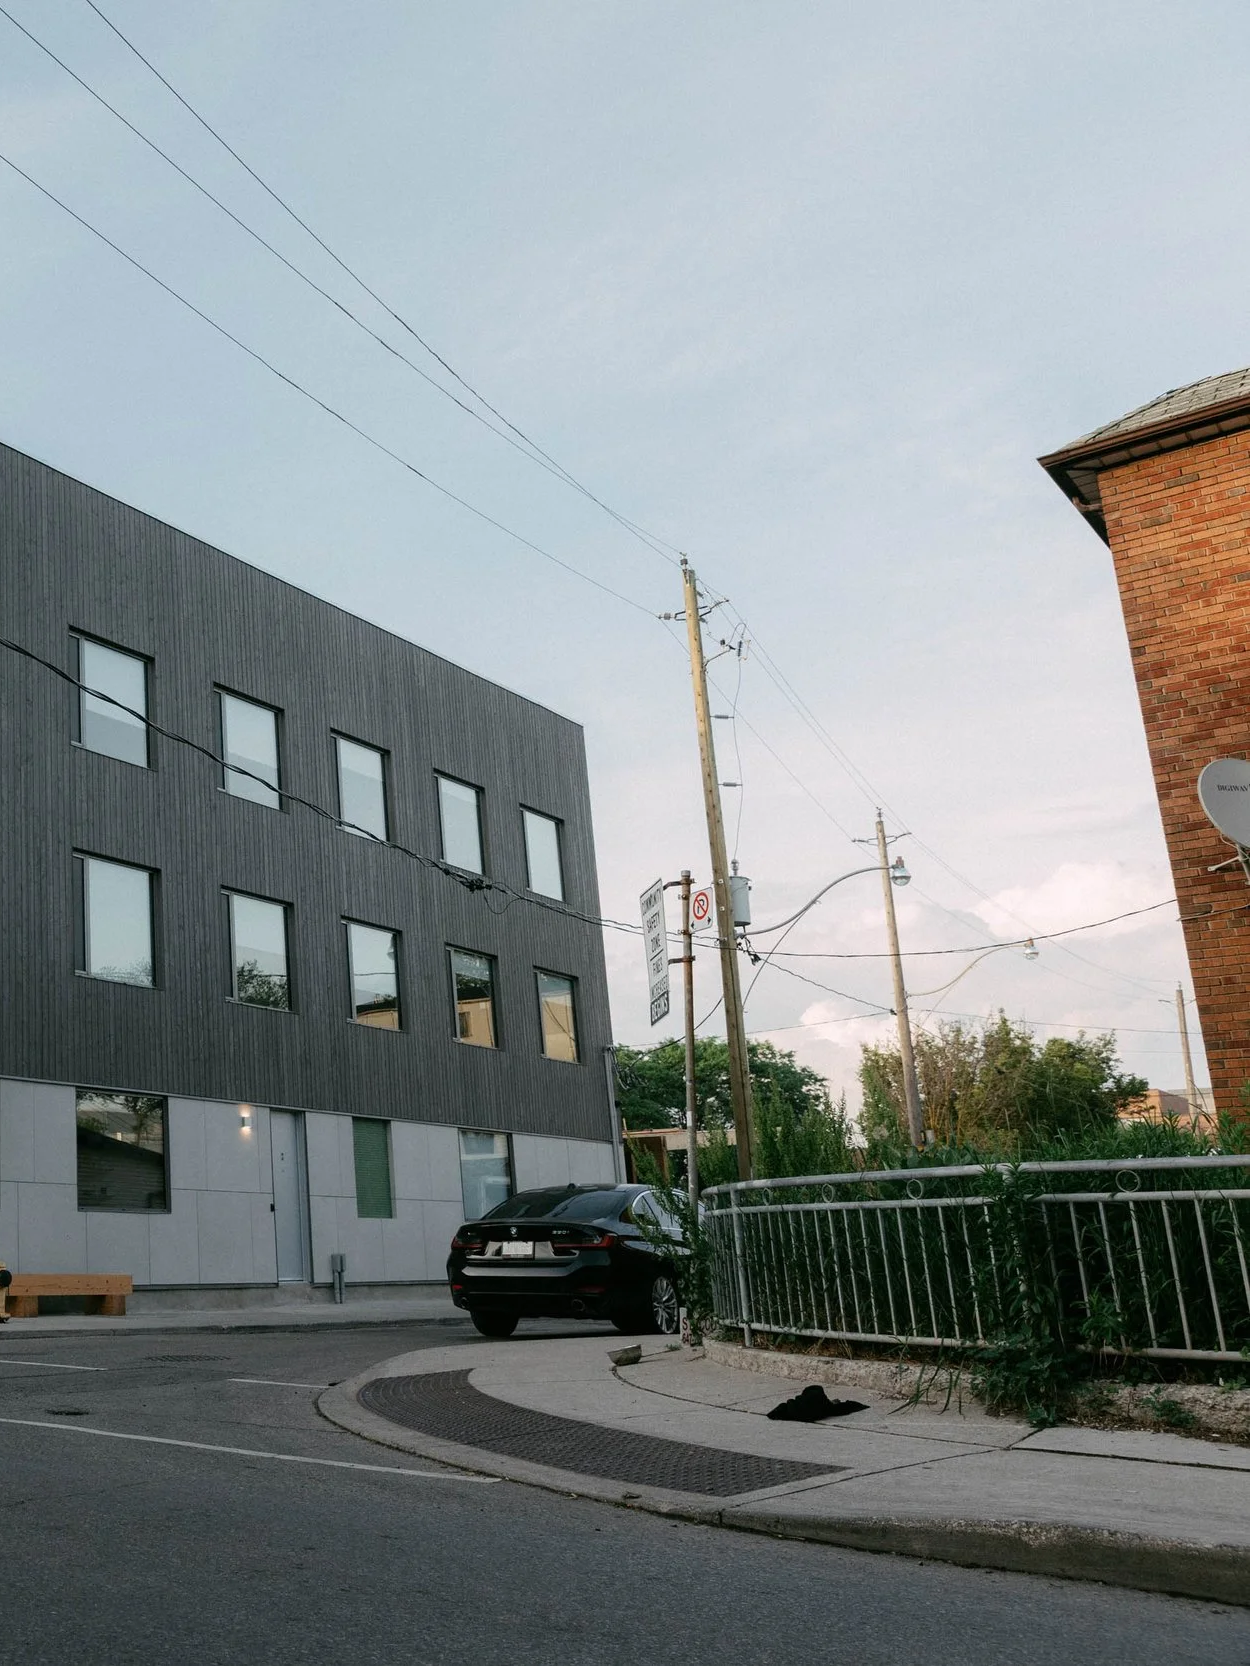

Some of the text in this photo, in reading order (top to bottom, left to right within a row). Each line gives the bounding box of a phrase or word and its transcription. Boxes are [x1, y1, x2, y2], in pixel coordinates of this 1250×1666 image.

[642, 889, 662, 916] COMMUNITY
[647, 911, 661, 933] SAFETY
[651, 933, 661, 953] ZONE
[652, 957, 663, 976] FINES
[651, 974, 669, 998] INCREASED
[652, 993, 668, 1022] BEGINS
